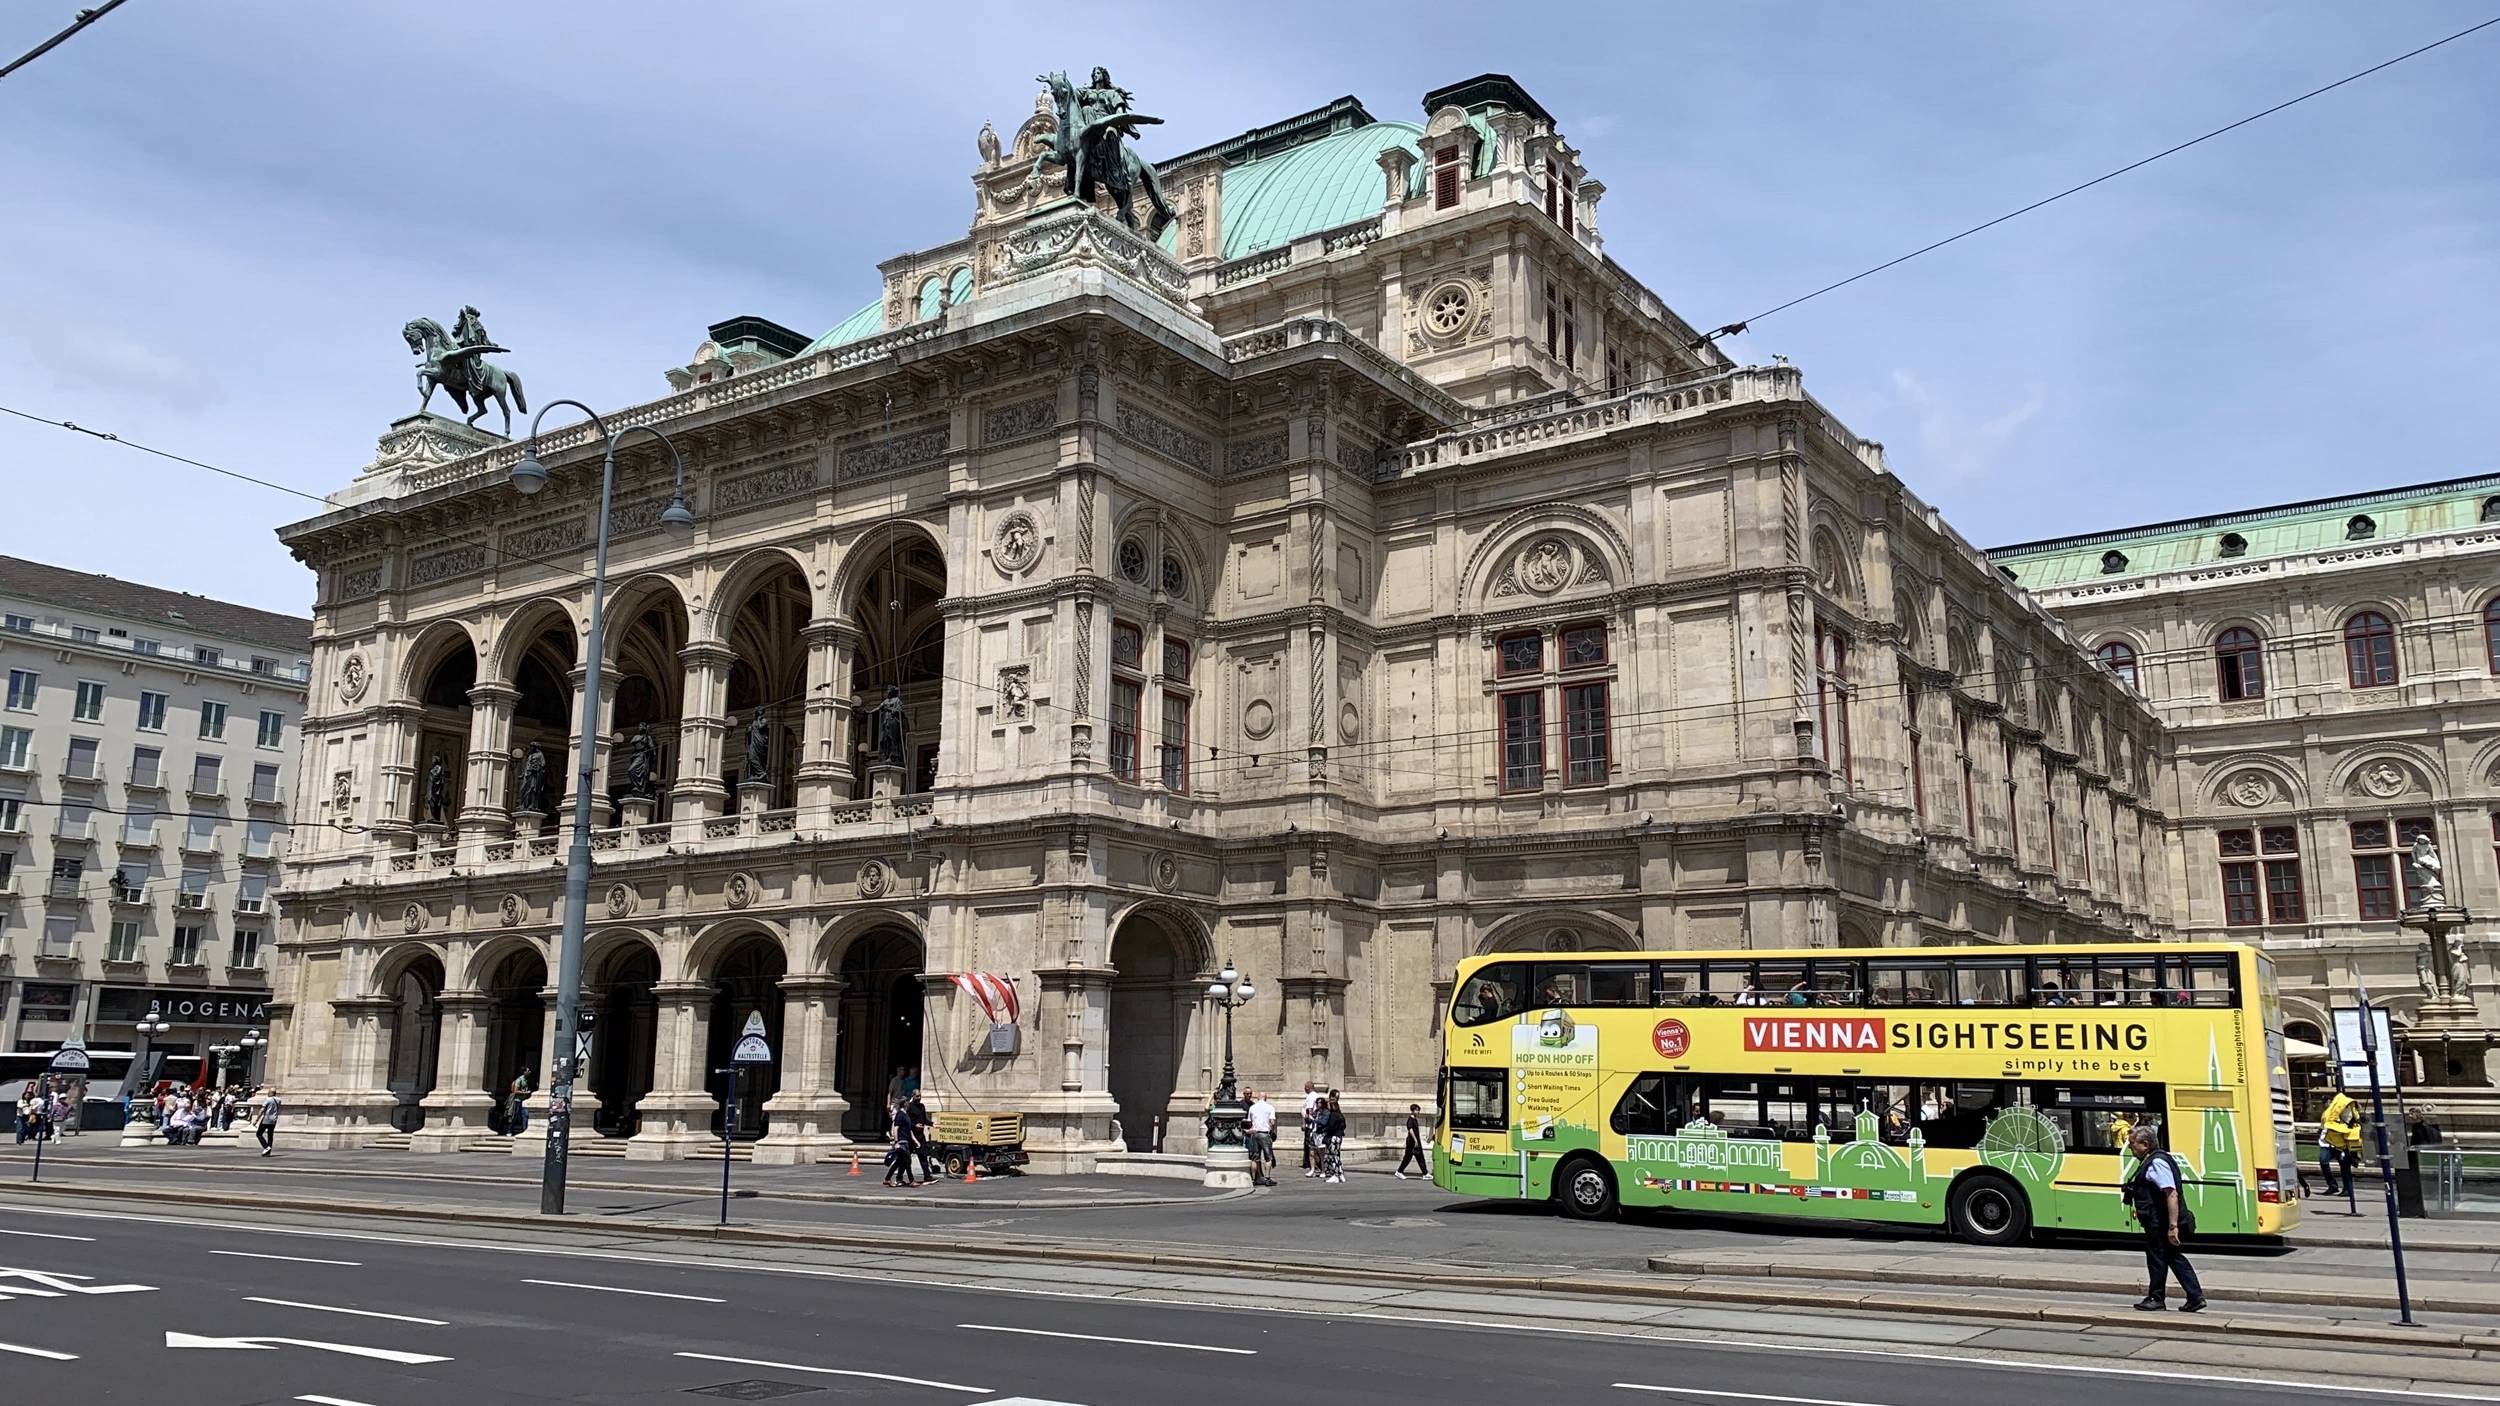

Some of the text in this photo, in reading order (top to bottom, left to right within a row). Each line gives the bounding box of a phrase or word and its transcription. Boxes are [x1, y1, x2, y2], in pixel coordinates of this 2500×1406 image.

[149, 1000, 265, 1018] BIOGENA
[742, 1037, 765, 1049] AUTOBUS
[1748, 1021, 2148, 1051] VIENNA SIGHTSEEING
[2233, 1009, 2245, 1084] #viennasightseeing
[1516, 1053, 1594, 1064] HOP ON HOP OFF
[2005, 1058, 2150, 1072] simply the best
[1577, 1071, 1592, 1079] Stops
